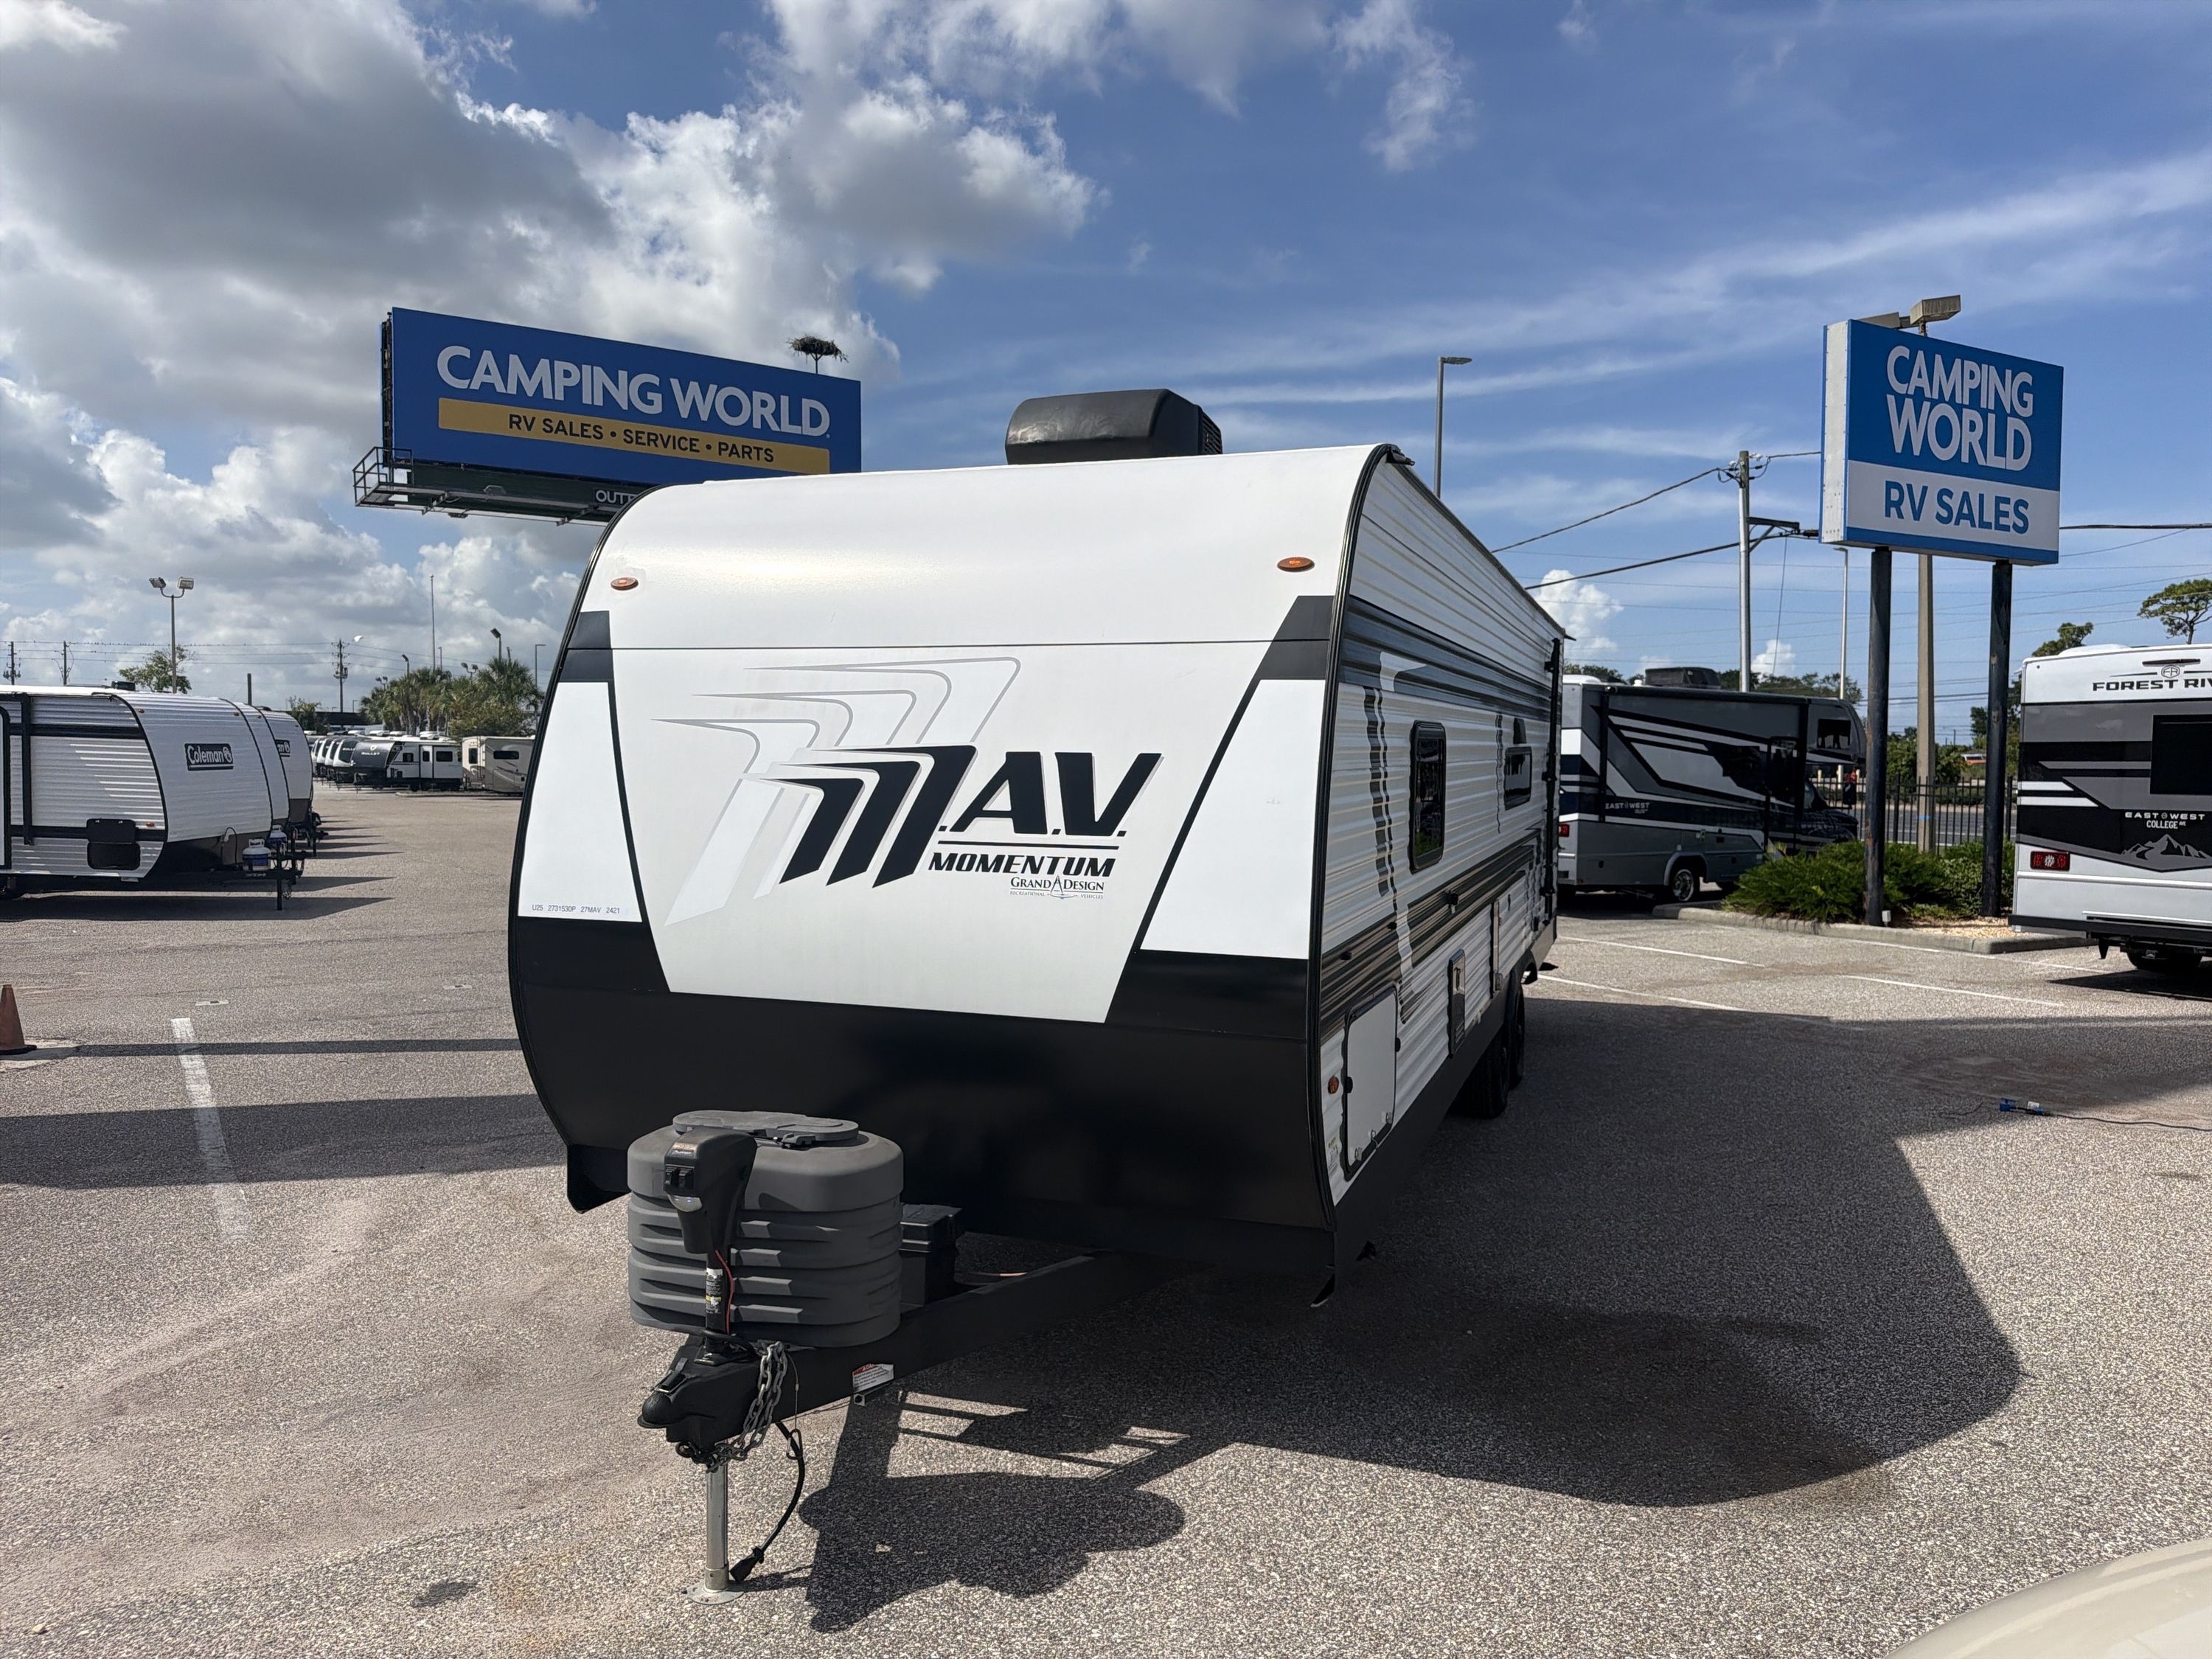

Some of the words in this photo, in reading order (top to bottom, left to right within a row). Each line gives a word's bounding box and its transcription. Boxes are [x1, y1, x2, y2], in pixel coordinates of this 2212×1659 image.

[437, 346, 662, 414] CAMPING
[669, 378, 830, 437] WORLD
[1887, 345, 2034, 417] CAMPING
[509, 414, 536, 431] RV
[542, 418, 604, 439] SALES
[623, 428, 700, 453] SERVICE
[718, 442, 774, 462] PARTS
[1886, 394, 2032, 471] WORLD
[1885, 480, 1928, 521] RV
[1935, 487, 2029, 535] SALES
[2093, 680, 2178, 692] FOREST
[187, 745, 225, 764] Coleman
[2146, 820, 2179, 830] COLLEGE
[928, 852, 1116, 877] MOMENTUM
[1010, 877, 1051, 889] GRAND
[1063, 879, 1105, 891] DESIGN
[548, 905, 577, 913] 2731530P
[580, 905, 602, 914] 27MAV
